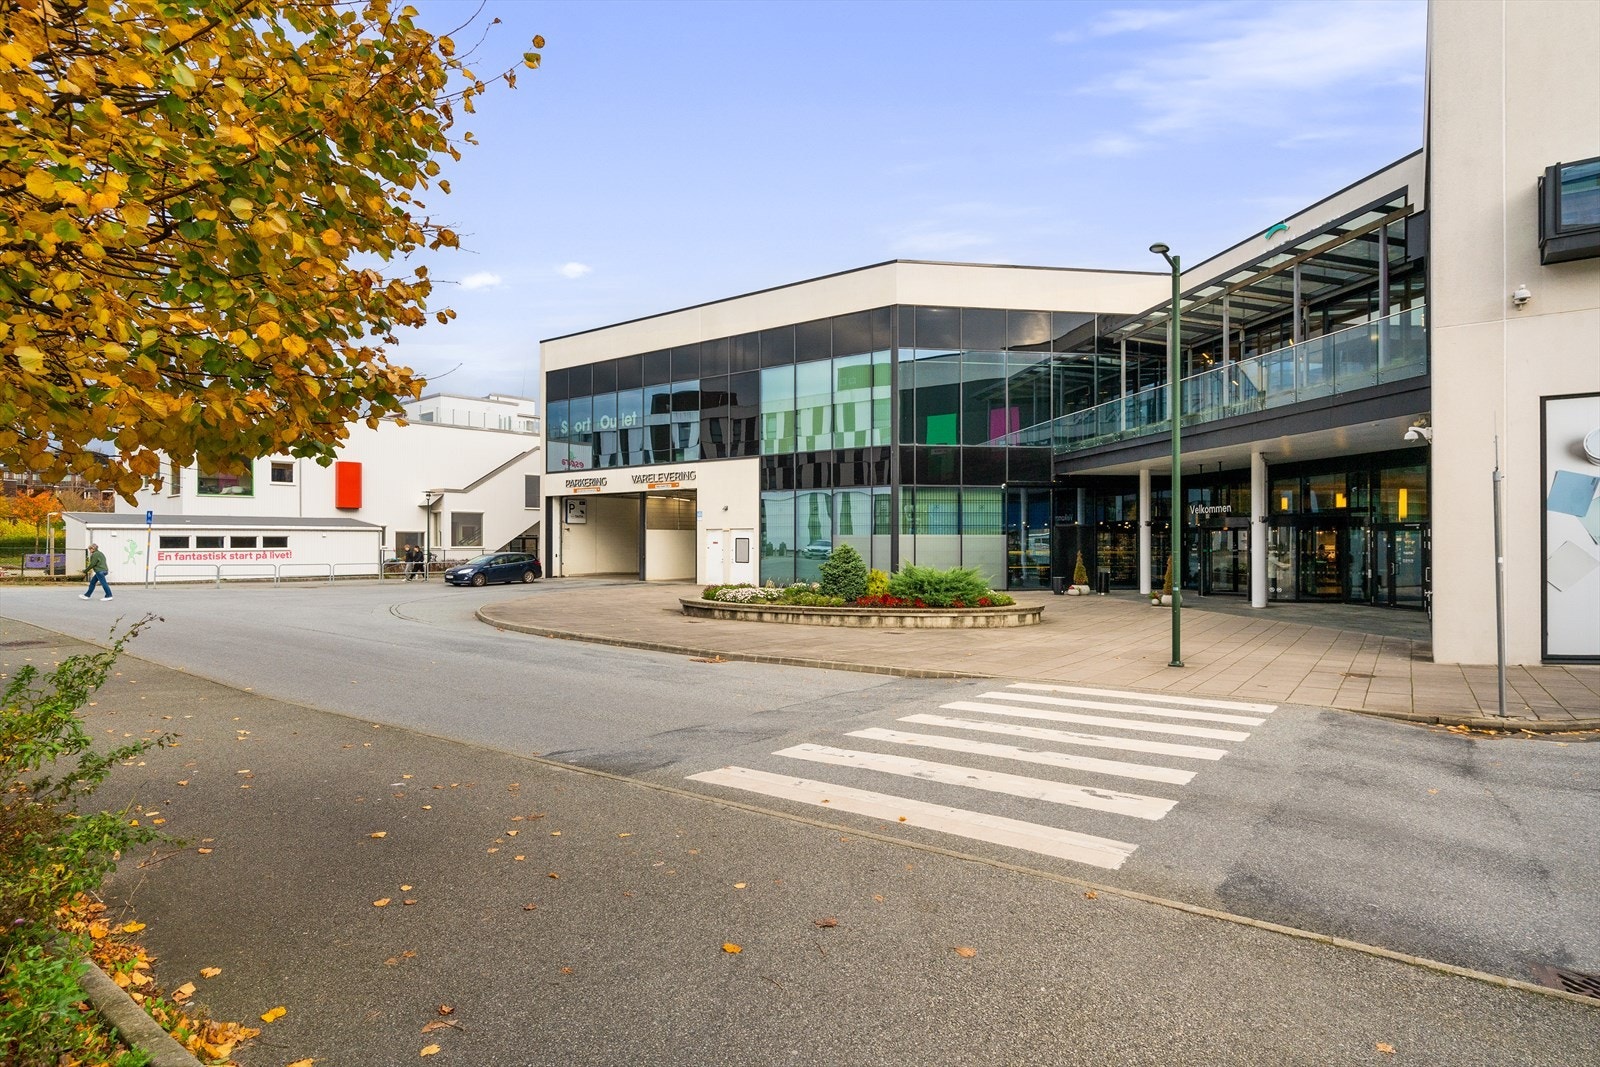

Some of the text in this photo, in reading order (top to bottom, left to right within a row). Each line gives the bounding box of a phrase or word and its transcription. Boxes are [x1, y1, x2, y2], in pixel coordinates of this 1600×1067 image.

[560, 411, 638, 434] Sort Oulet
[565, 477, 608, 488] PARKERING
[631, 470, 697, 484] VARELEVERING
[568, 503, 576, 514] P
[1189, 504, 1232, 515] Velkommen
[157, 550, 292, 561] En fantastisk start på livet!
